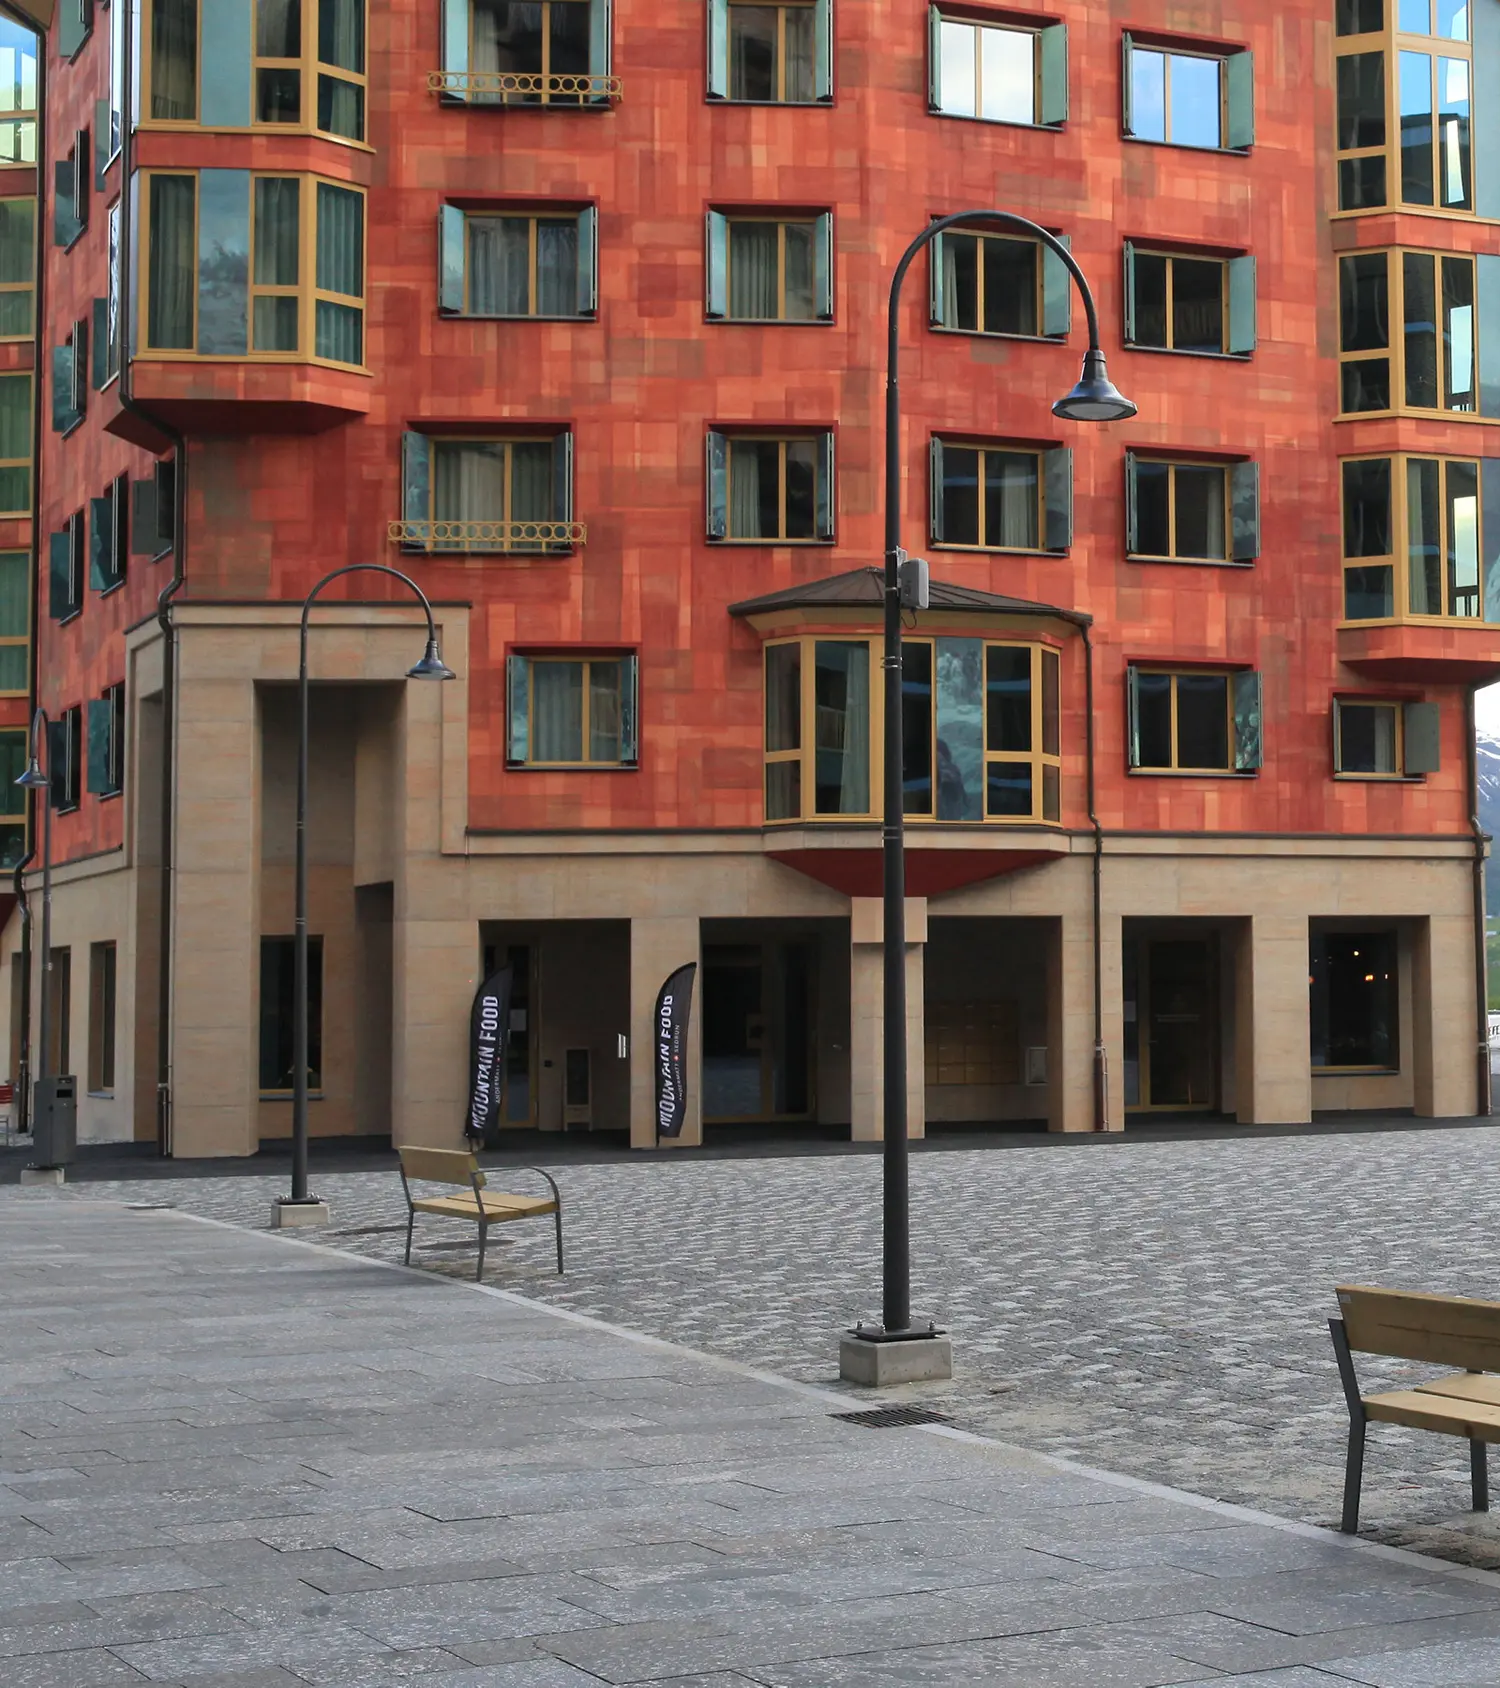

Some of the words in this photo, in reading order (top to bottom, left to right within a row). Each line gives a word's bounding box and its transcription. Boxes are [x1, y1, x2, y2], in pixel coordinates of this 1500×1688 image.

[479, 996, 499, 1041] FOOD
[660, 995, 673, 1039] FOOD
[472, 1046, 495, 1128] MOUNTAIN
[659, 1043, 675, 1128] MOUNTAIN
